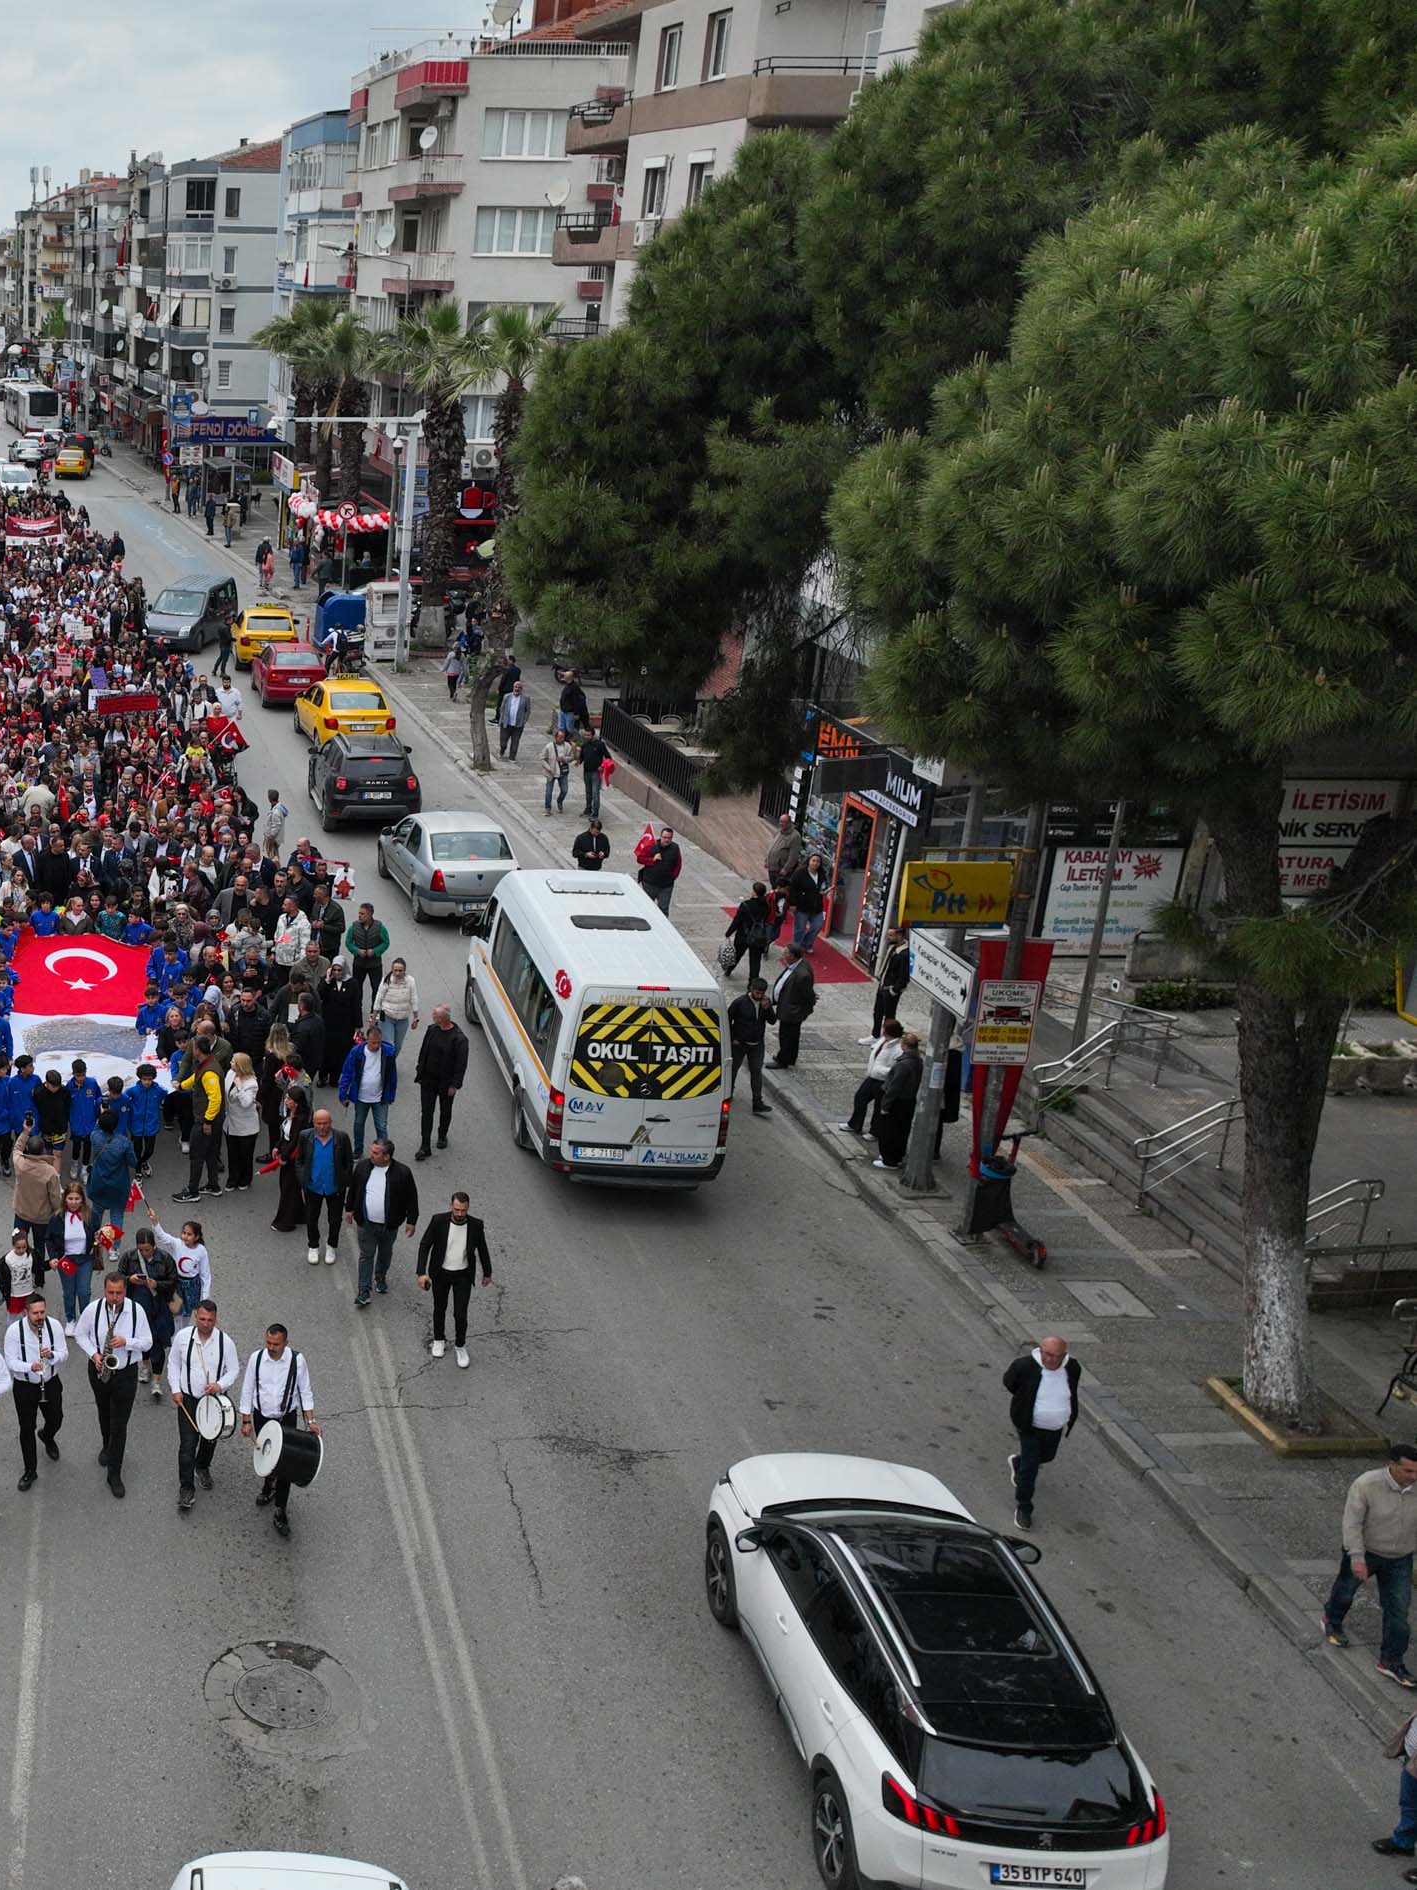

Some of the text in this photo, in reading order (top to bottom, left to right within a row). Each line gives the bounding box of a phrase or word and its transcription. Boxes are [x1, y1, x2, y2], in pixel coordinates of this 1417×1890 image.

[885, 771, 922, 811] MIUM
[587, 1042, 714, 1065] OKUL TAŞITI
[1001, 1864, 1082, 1883] 35 BTP 640
